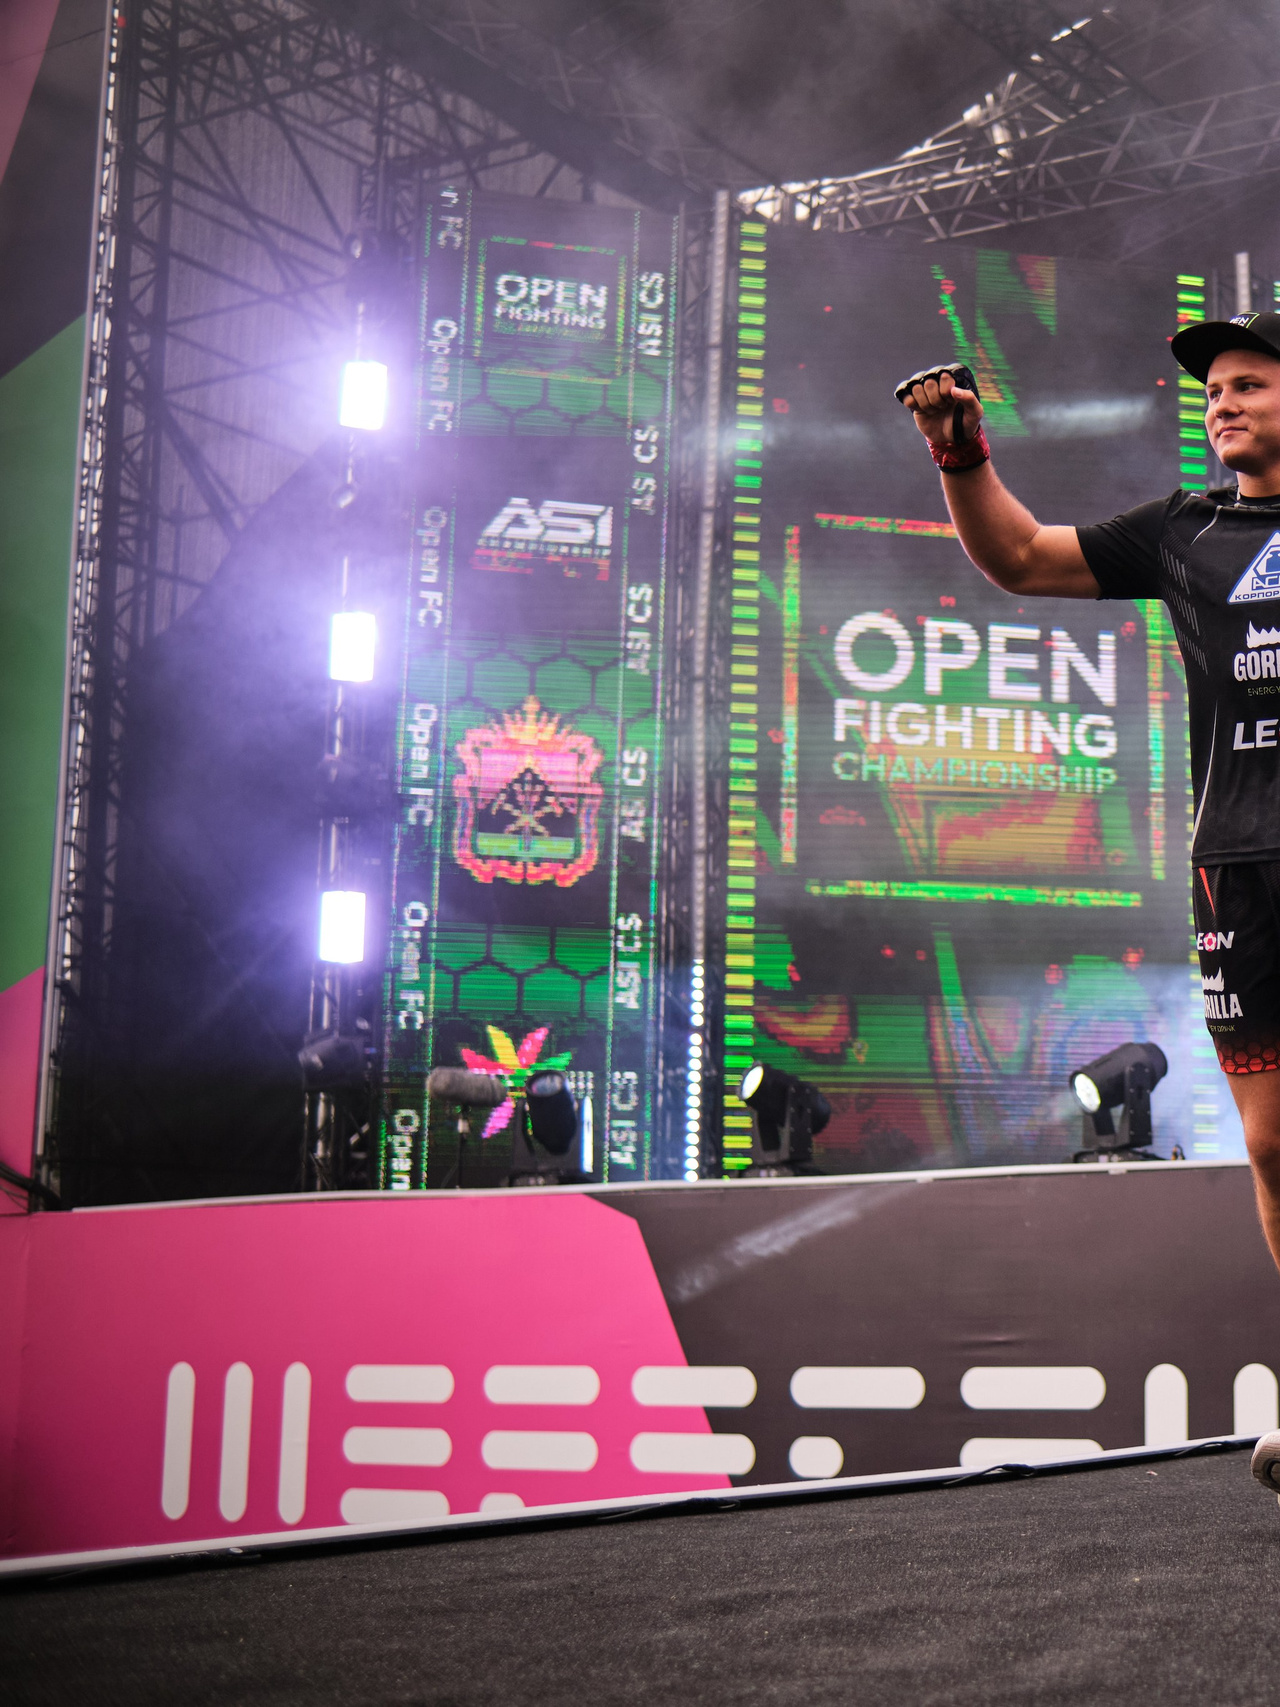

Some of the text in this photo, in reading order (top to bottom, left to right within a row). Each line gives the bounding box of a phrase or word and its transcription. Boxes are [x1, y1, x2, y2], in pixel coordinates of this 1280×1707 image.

[496, 273, 609, 308] OPEN
[494, 300, 607, 330] FIGHTING
[481, 496, 614, 547] ASI
[834, 611, 1117, 707] OPEN
[833, 697, 1118, 758] FIGHTING
[832, 750, 1118, 794] CHAMPIONSHIP
[1196, 931, 1235, 952] EON
[1204, 993, 1244, 1020] RILLA
